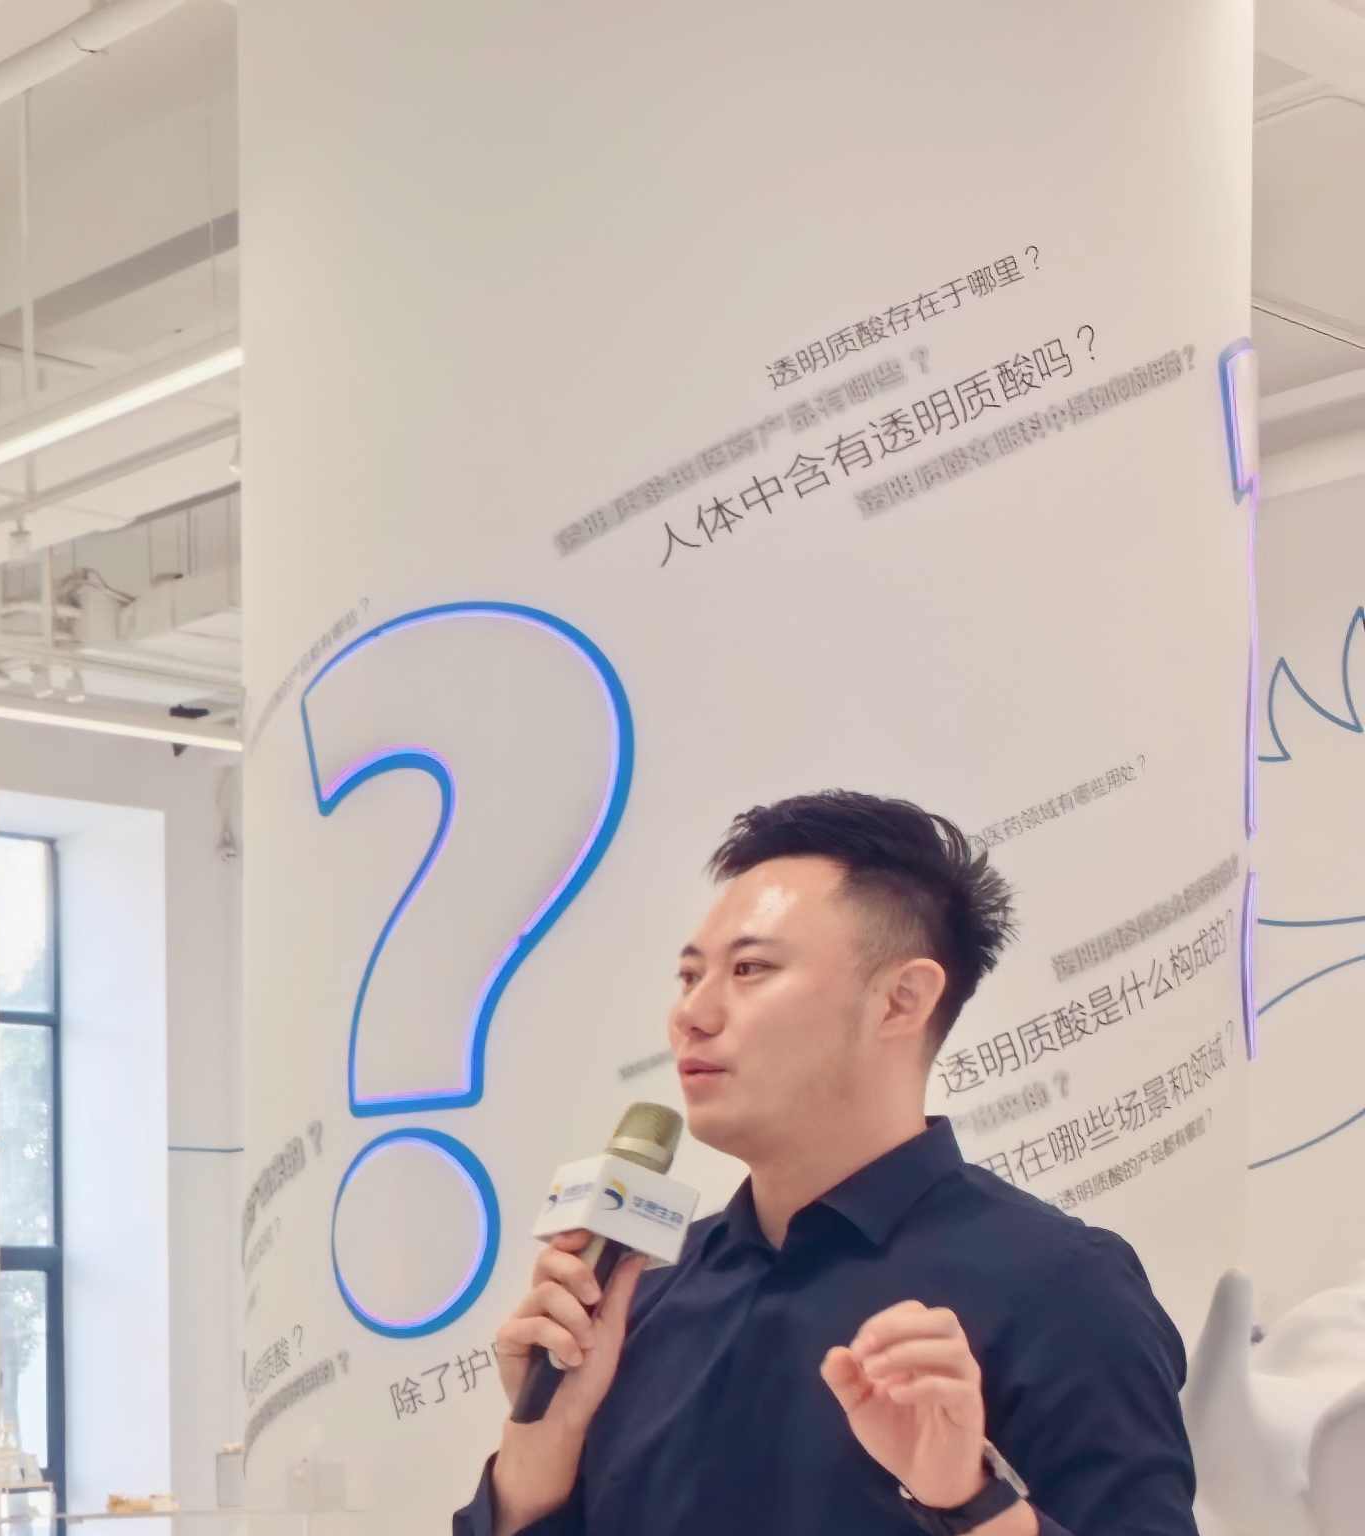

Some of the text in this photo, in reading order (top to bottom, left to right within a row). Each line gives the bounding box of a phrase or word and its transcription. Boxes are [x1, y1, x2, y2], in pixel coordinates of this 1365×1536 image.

[765, 245, 1040, 390] 透明质酸存在于哪里？
[661, 324, 1096, 567] 人体中含有透明质酸吗？
[935, 908, 1234, 1098] 透明质酸是什么构成的？
[389, 1341, 499, 1420] 除了护
